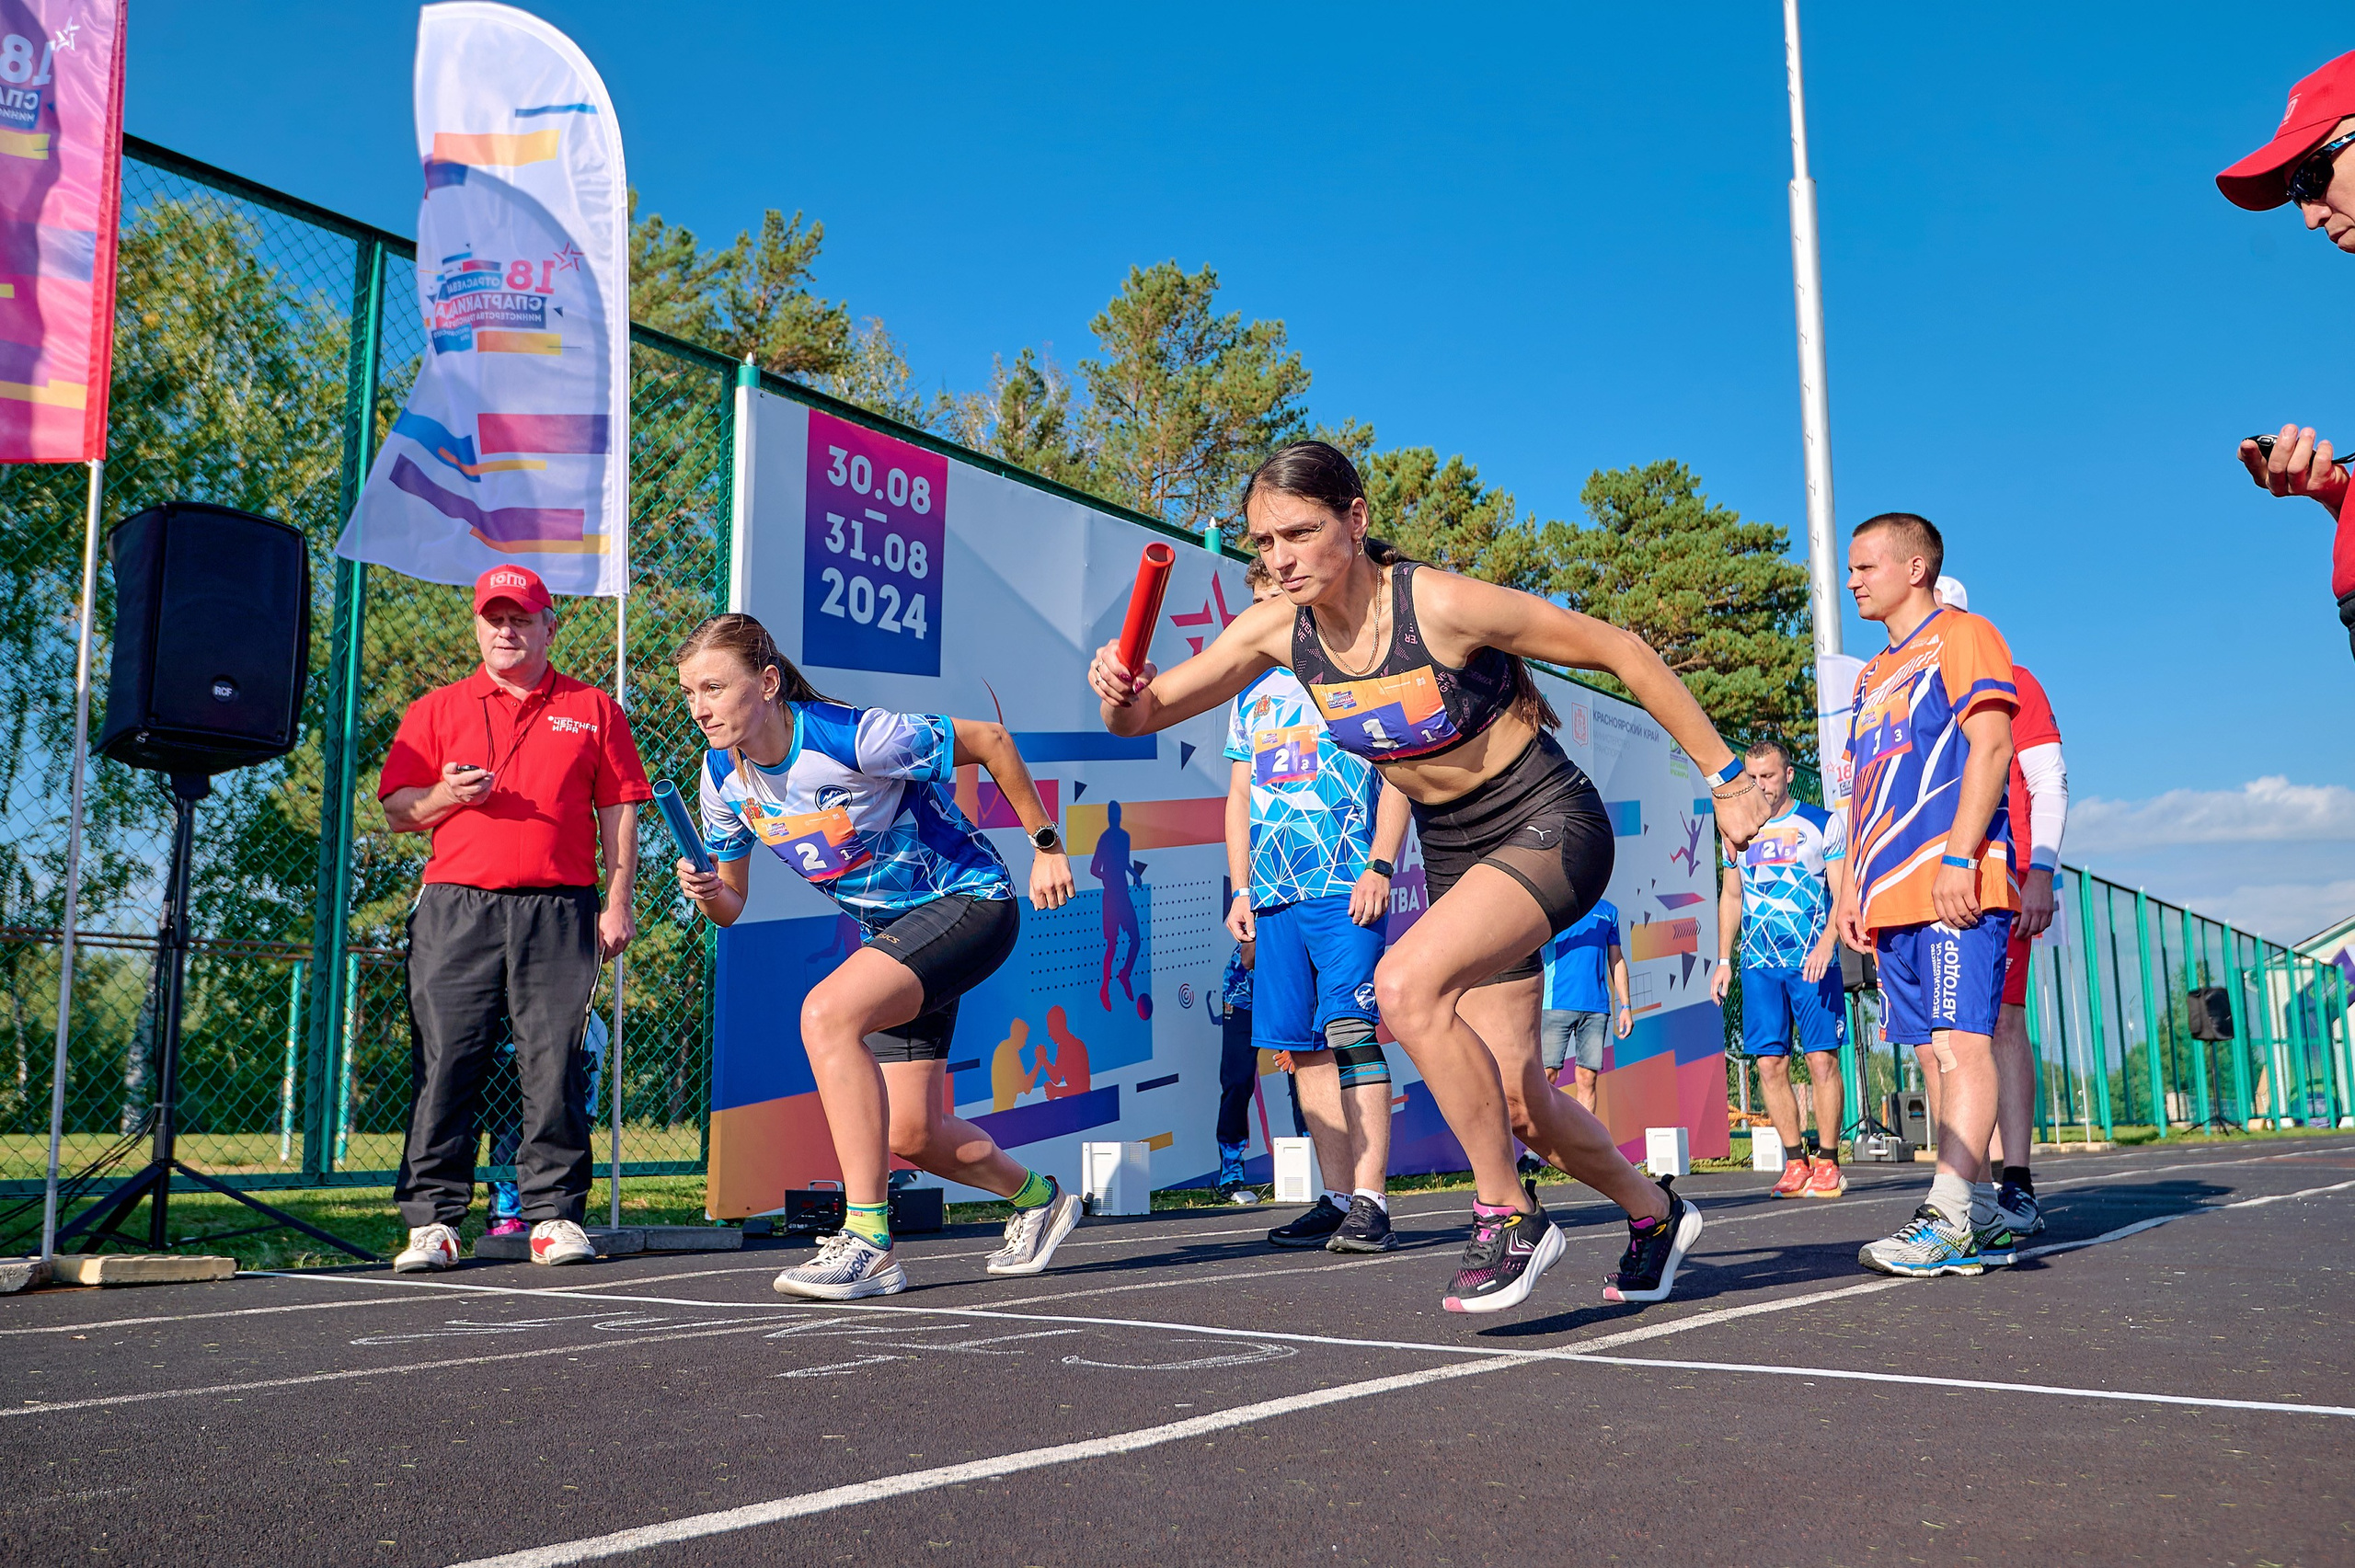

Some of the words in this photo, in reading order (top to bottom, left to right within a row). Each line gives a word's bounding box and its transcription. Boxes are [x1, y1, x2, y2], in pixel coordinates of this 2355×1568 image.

[826, 445, 932, 515] 30.08
[824, 511, 928, 579] 31.08
[820, 566, 927, 640] 2024
[214, 685, 233, 697] RCF
[552, 725, 579, 734] ИГРА
[554, 719, 598, 733] ЧЕСТНАЯ
[1361, 718, 1400, 750] 1
[1420, 728, 1438, 744] 1
[1592, 710, 1643, 737] КРАСНОЯРСКИЙ
[1643, 727, 1660, 743] КРАЙ
[1894, 728, 1903, 742] 3
[1272, 748, 1290, 773] 2
[1301, 759, 1310, 771] 3
[1837, 763, 1852, 783] 18
[795, 841, 828, 871] 2
[839, 849, 853, 861] 1
[1763, 841, 1776, 859] 2
[1785, 848, 1791, 856] 5
[1943, 940, 1961, 1023] АВТОДОР
[846, 1249, 874, 1280] HOKA
